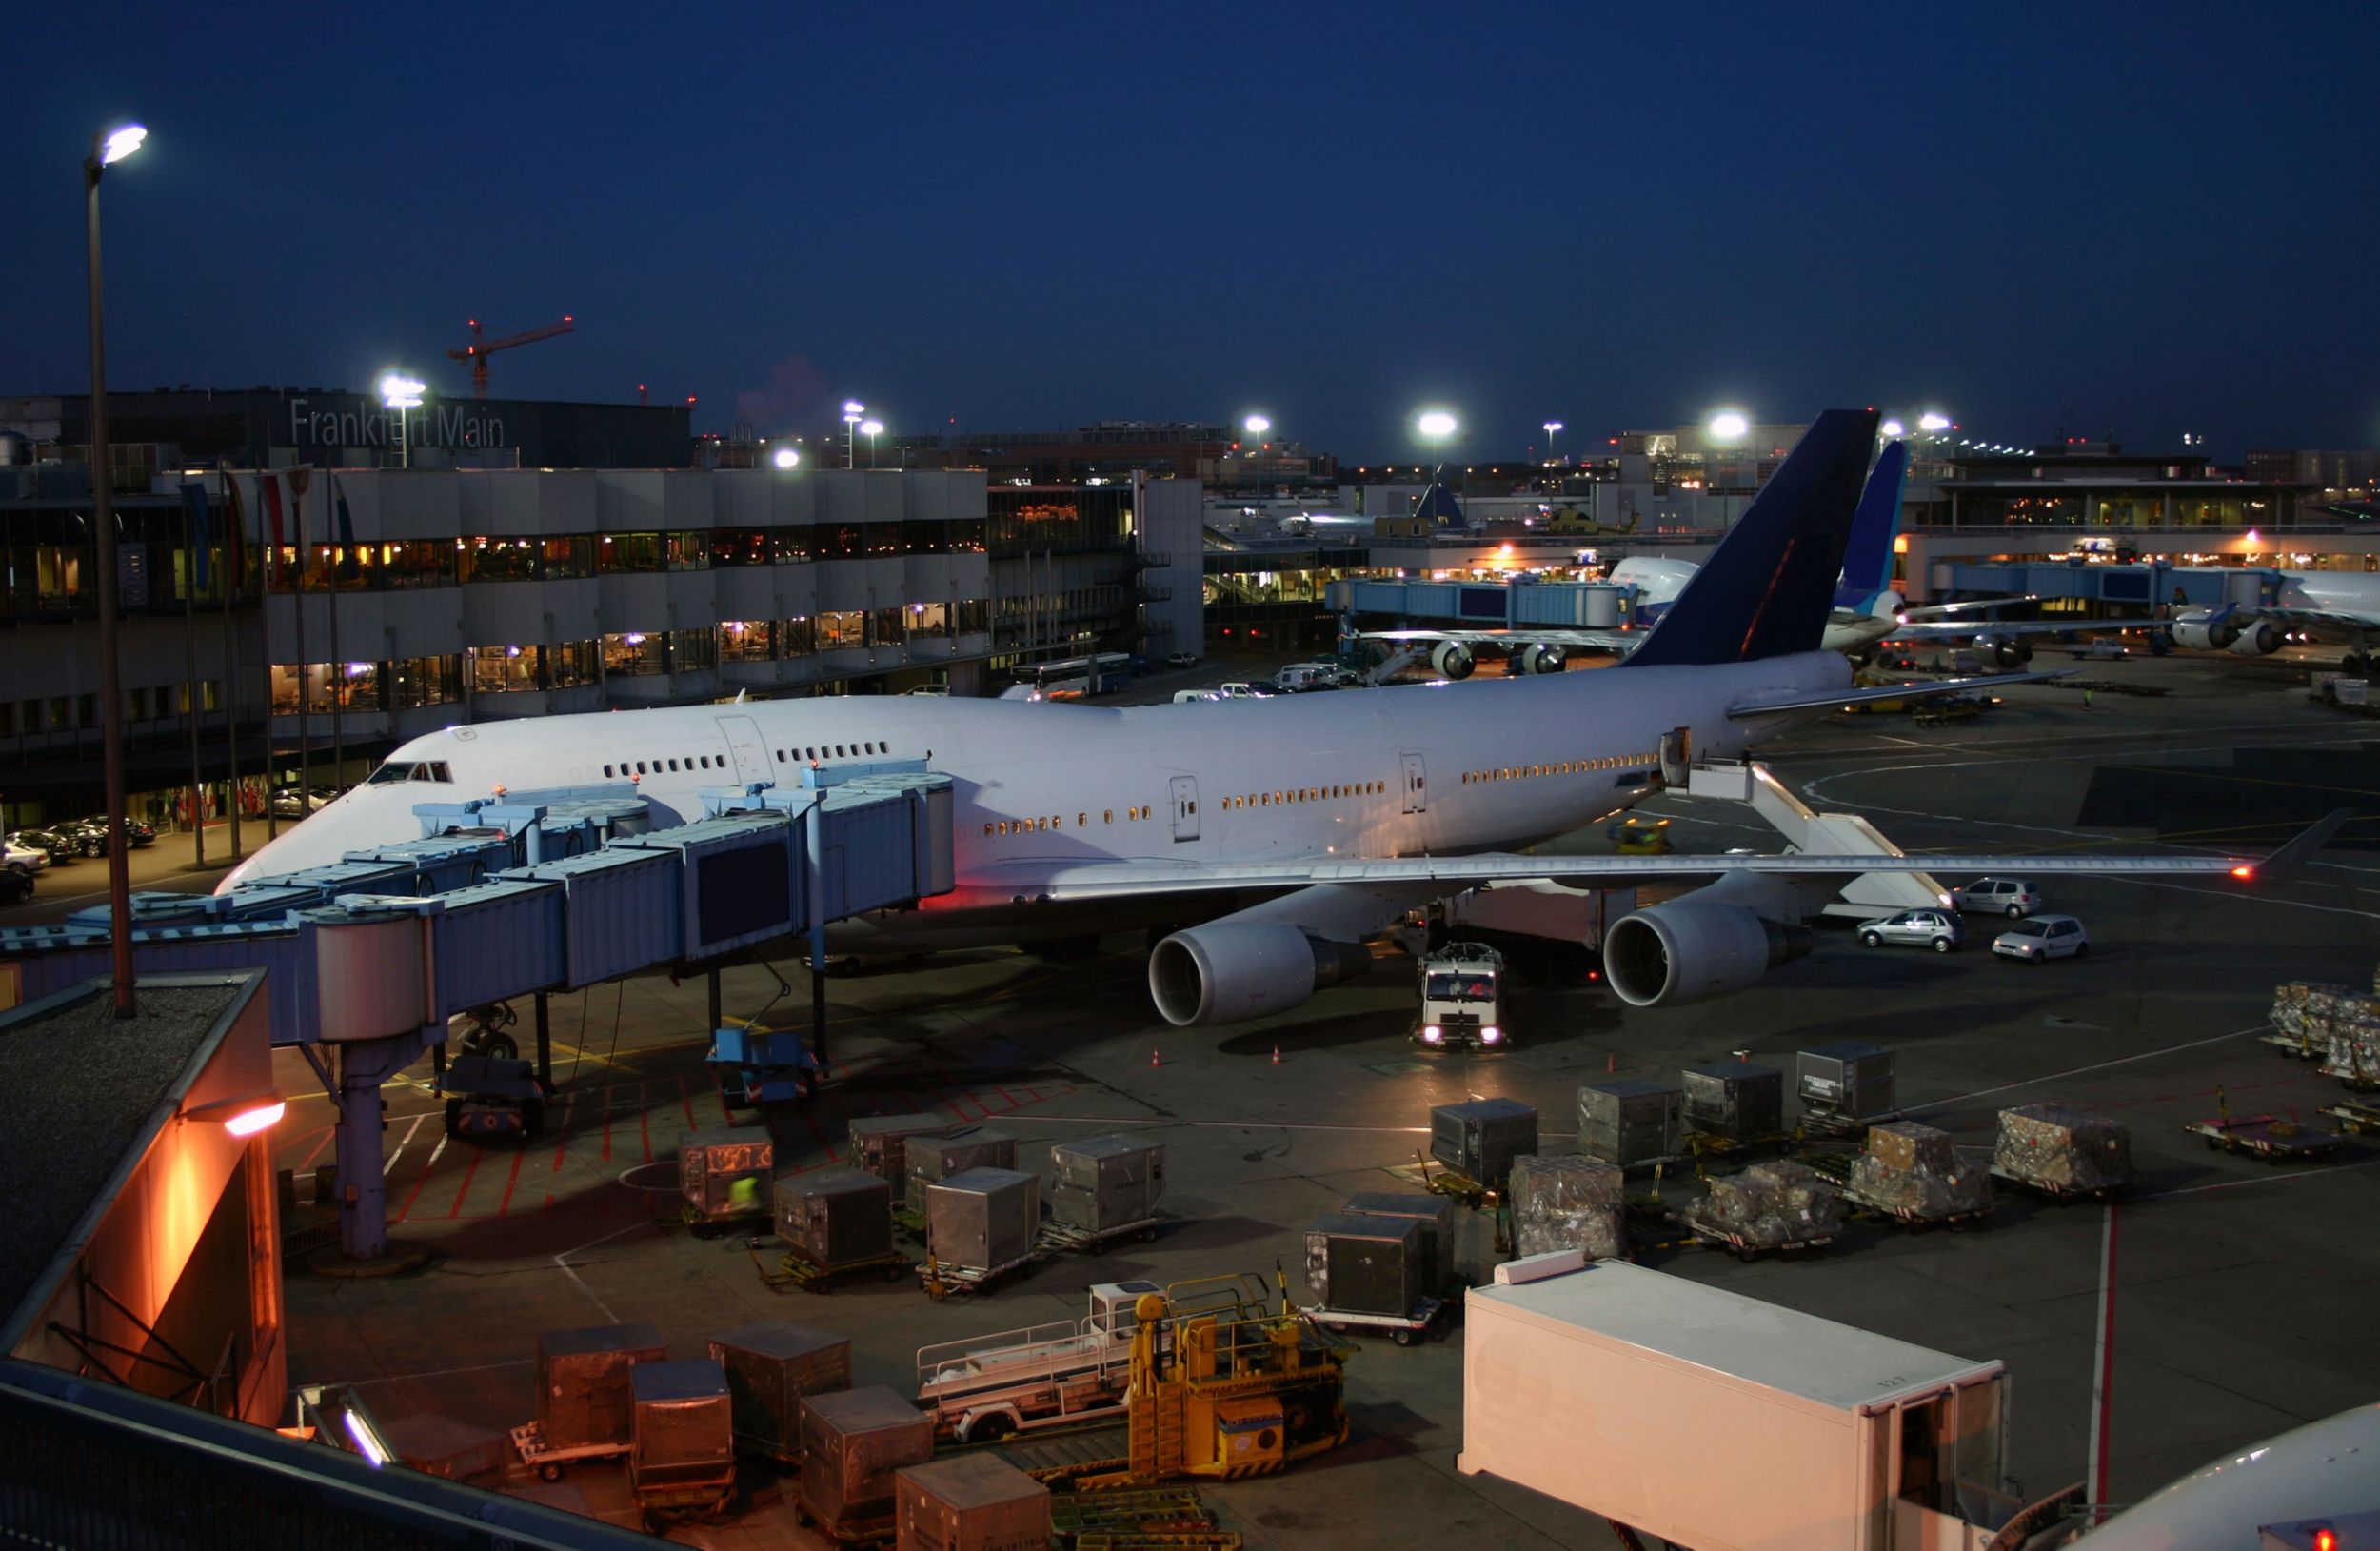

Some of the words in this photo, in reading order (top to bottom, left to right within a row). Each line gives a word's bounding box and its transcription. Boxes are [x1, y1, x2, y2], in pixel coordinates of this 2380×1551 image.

[290, 398, 430, 447] Frankfurt
[436, 404, 504, 447] Main
[1877, 1376, 1907, 1388] 127
